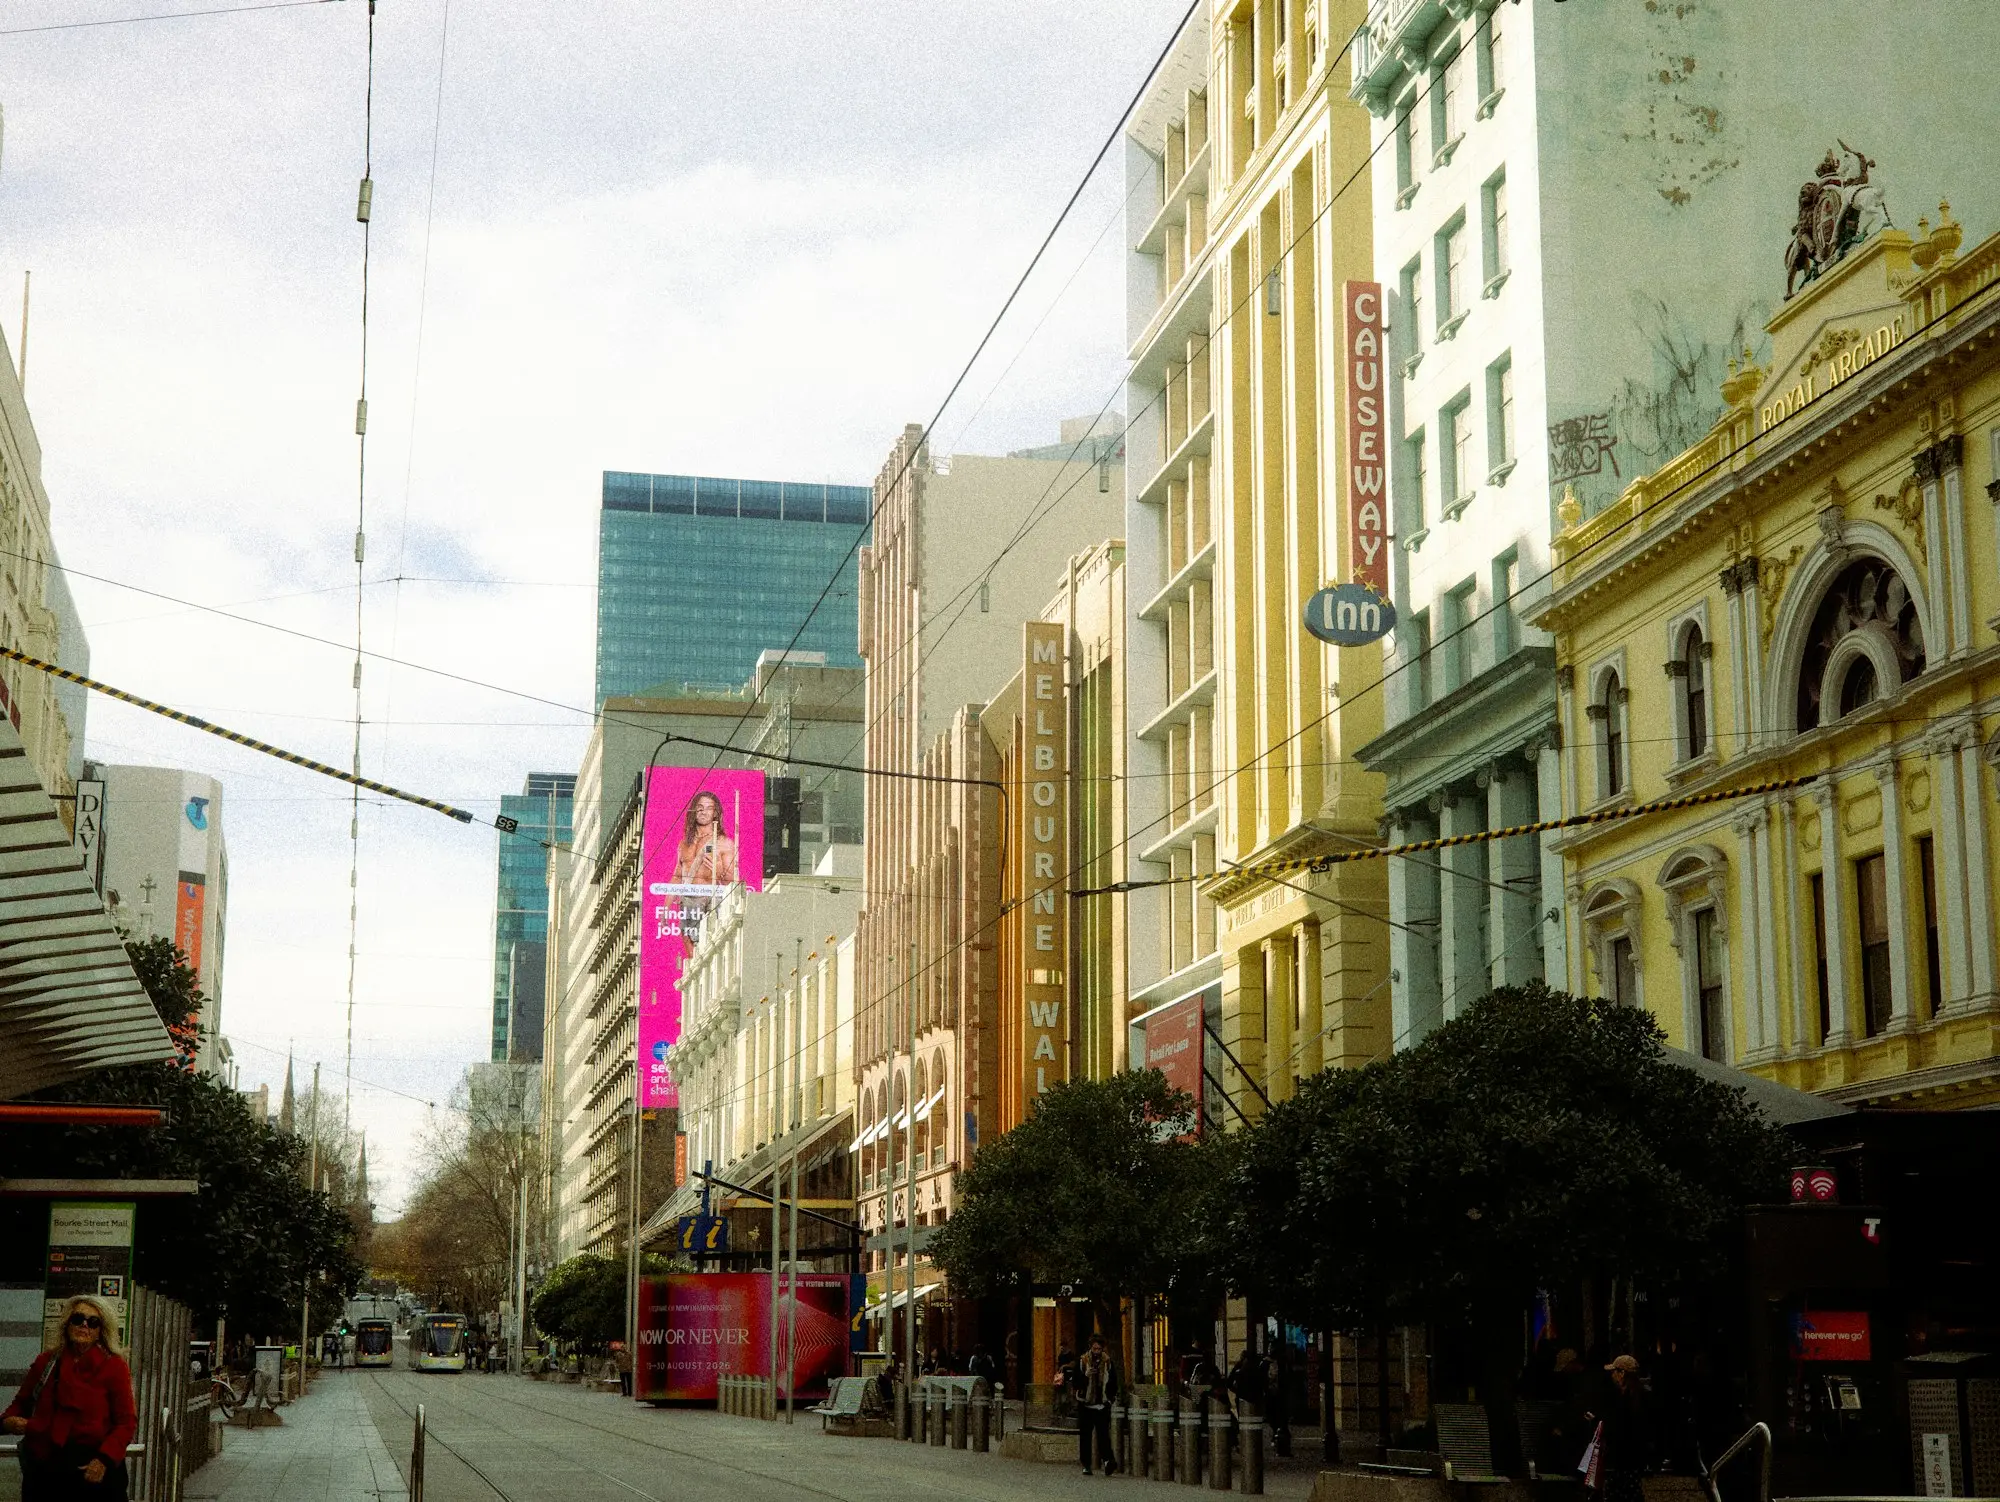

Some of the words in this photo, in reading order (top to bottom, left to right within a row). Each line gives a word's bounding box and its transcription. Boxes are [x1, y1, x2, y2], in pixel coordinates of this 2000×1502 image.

[1761, 376, 1820, 434] ROYAL
[1828, 315, 1906, 392] ARCADE
[1355, 293, 1384, 566] CAUSEWAY
[1323, 593, 1381, 632] Inn
[1032, 639, 1057, 951] MELBOURNE
[655, 905, 688, 920] Find
[656, 922, 681, 940] job
[54, 1219, 83, 1228] Bourke
[83, 1219, 110, 1228] Street
[111, 1219, 129, 1228] Mall
[118, 1303, 125, 1314] 5
[640, 1329, 668, 1345] NOW
[669, 1328, 691, 1344] OR
[693, 1328, 751, 1344] NEVER
[667, 1361, 703, 1370] AUGUST
